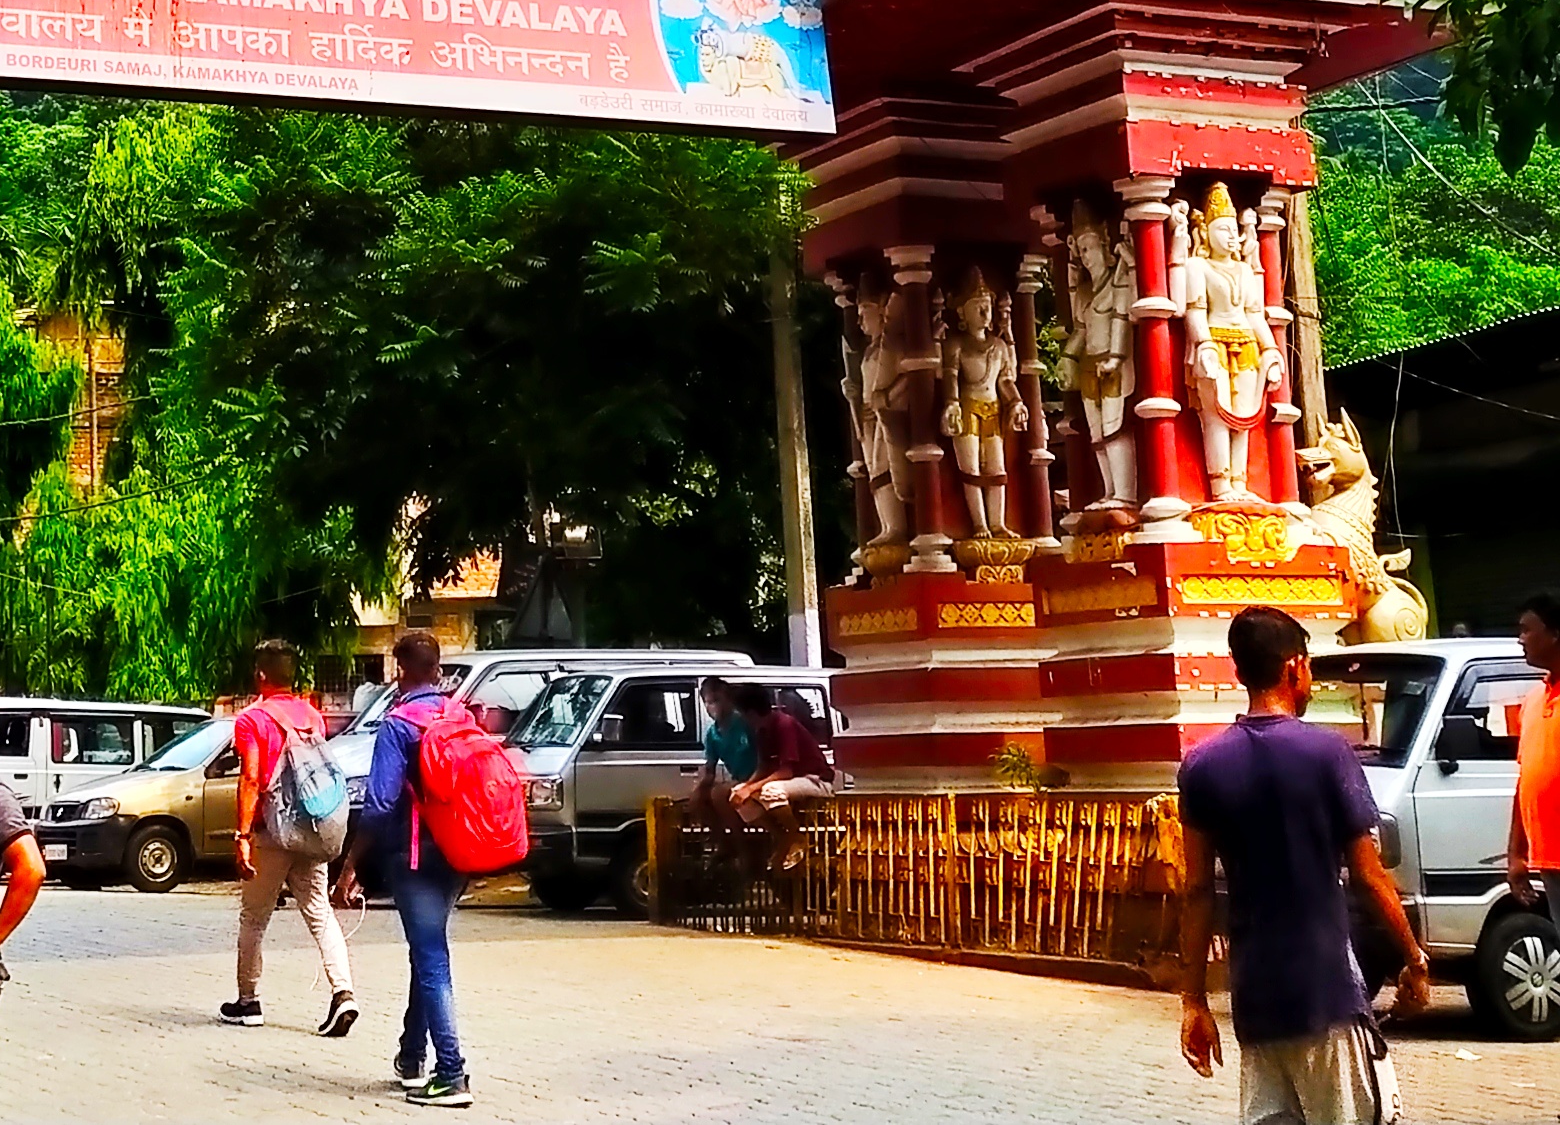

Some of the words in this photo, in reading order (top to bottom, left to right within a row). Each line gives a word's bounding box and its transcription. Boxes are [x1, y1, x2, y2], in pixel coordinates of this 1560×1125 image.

[6, 53, 98, 73] BORDEURI
[104, 59, 168, 80] SAMAJ,
[172, 65, 269, 85] KAMAKHYA
[275, 73, 360, 91] DEVALAYA
[173, 19, 292, 59] आपका
[308, 23, 414, 66] हार्दिक
[430, 32, 592, 80] अभिनन्दन
[606, 43, 631, 83] है
